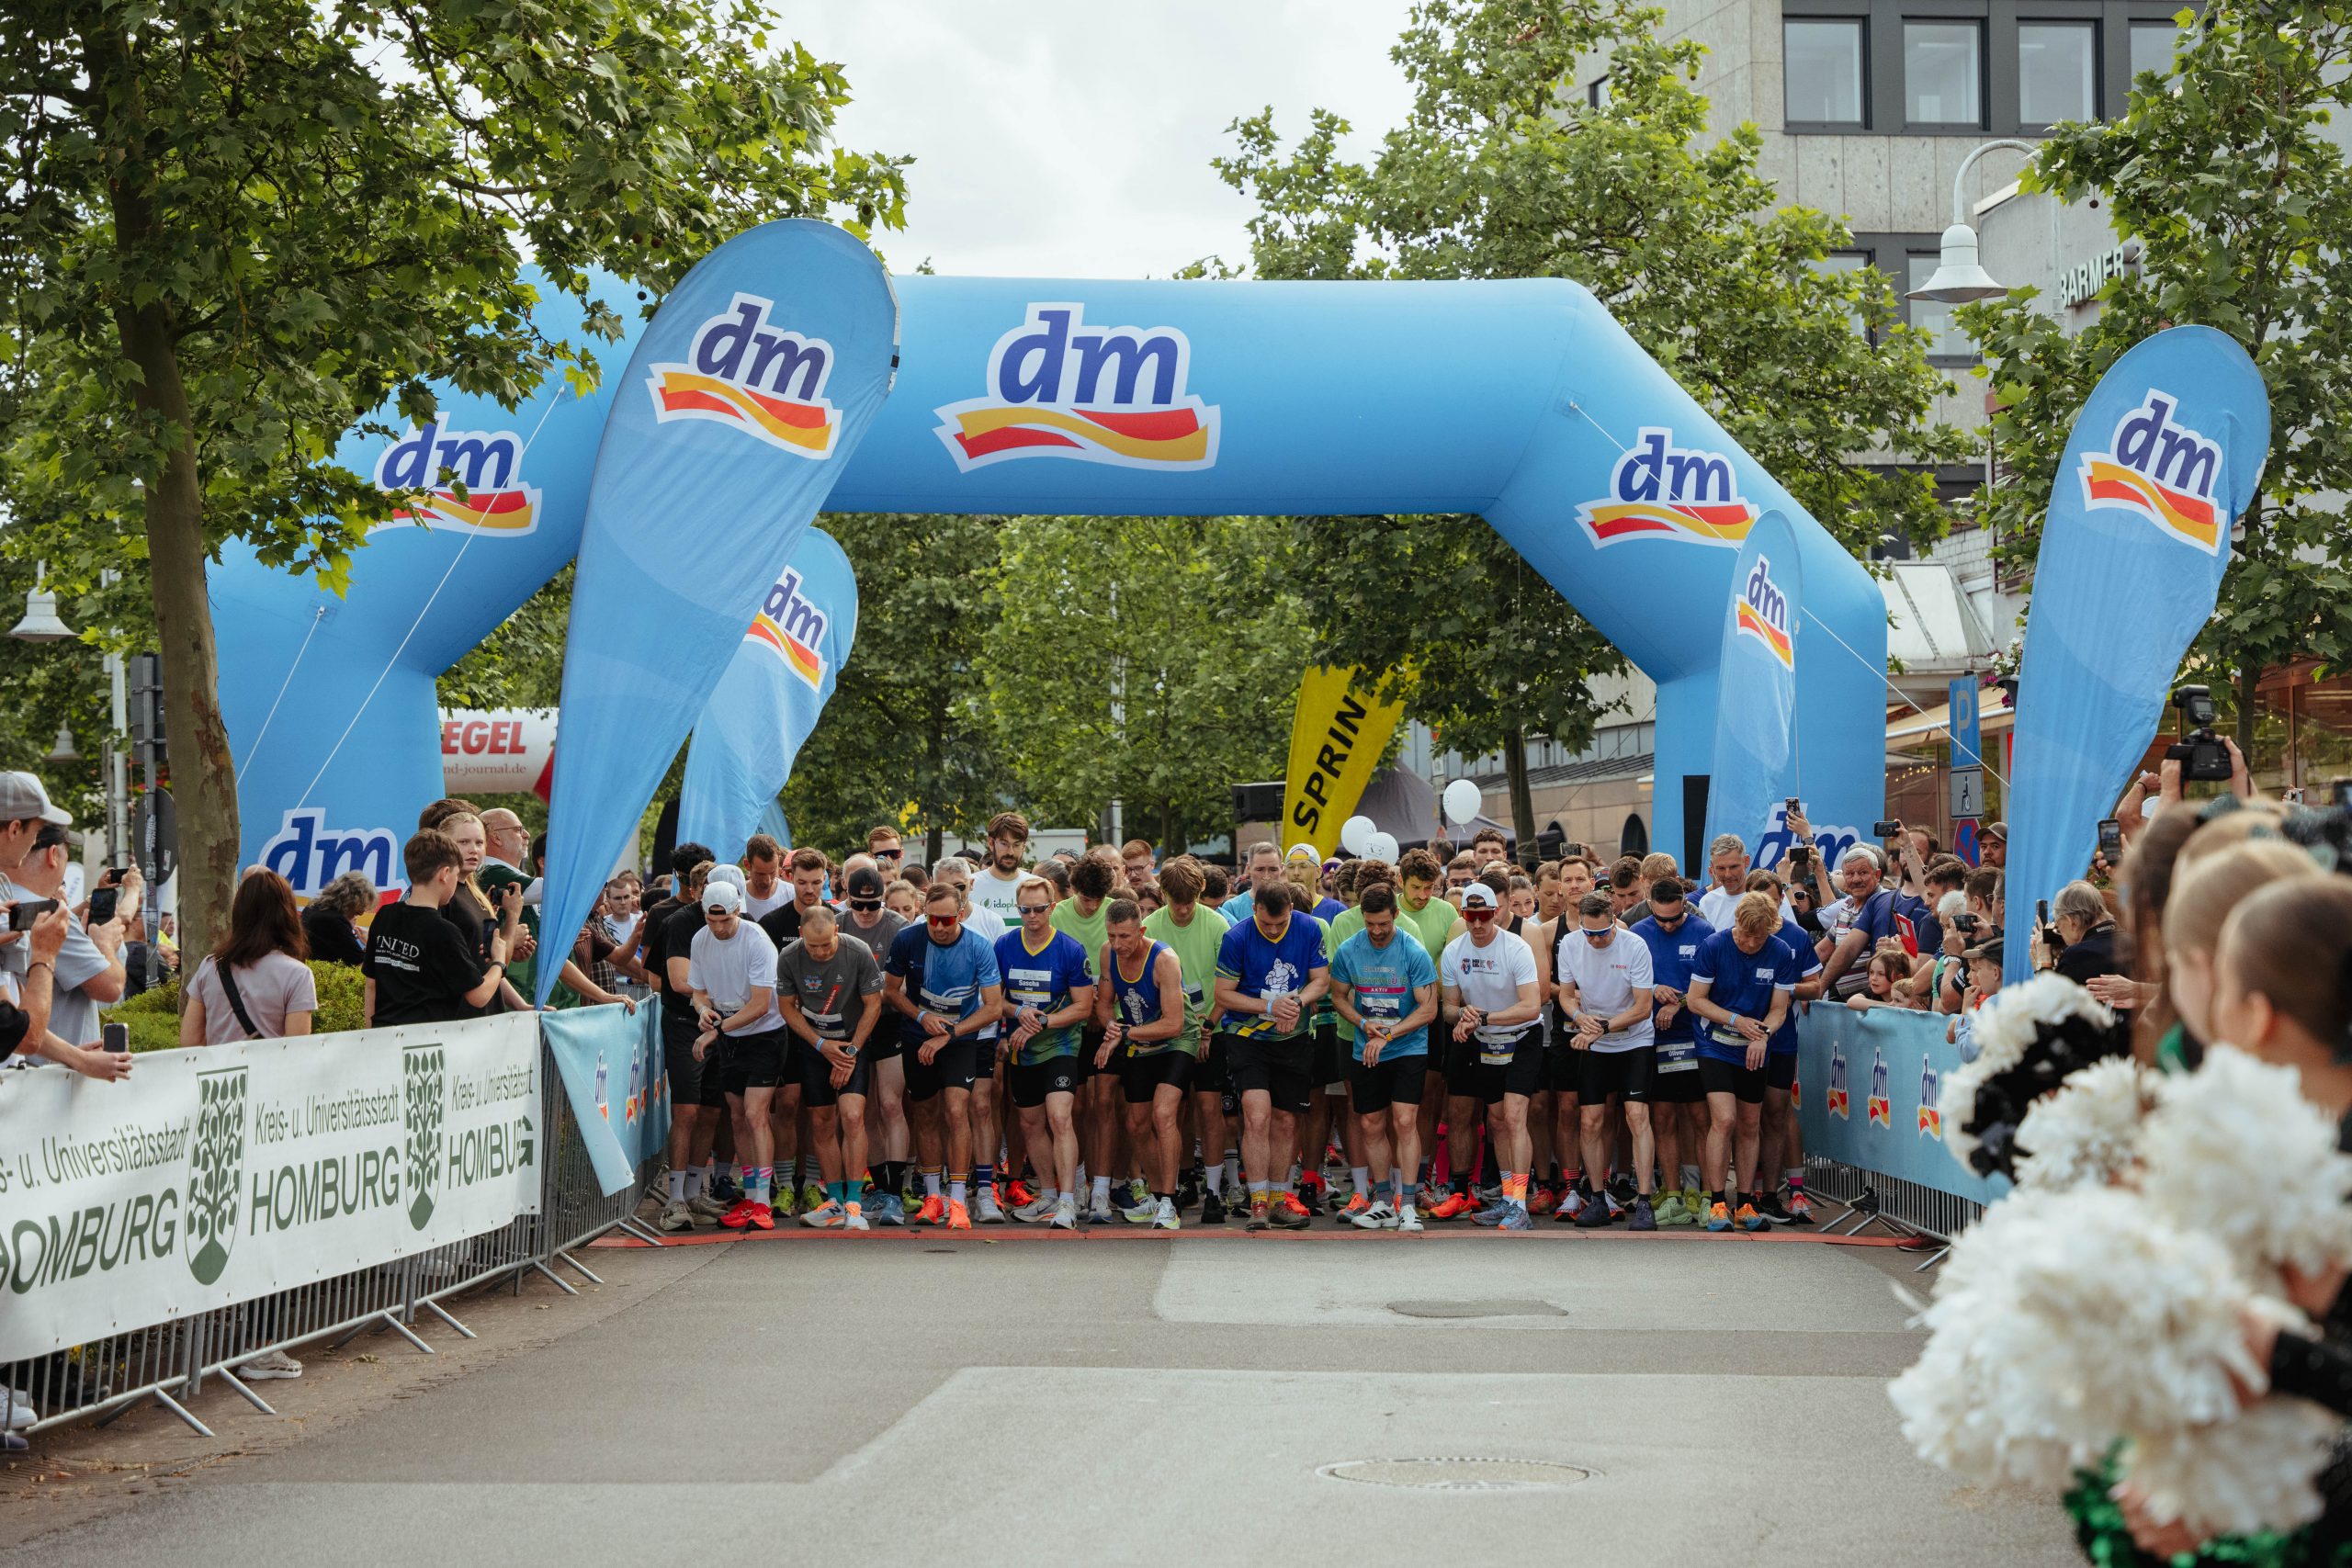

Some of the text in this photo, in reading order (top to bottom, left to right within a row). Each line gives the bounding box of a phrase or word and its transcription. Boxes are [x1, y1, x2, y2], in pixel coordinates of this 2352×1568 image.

[2060, 244, 2125, 308] BARMER
[695, 302, 827, 402] dm
[999, 310, 1179, 405] dm
[381, 419, 520, 489] dm
[1618, 434, 1731, 502] dm
[2116, 398, 2216, 497] dm
[763, 573, 825, 649] dm
[1747, 560, 1787, 632] dm
[1956, 690, 1972, 756] P
[1293, 691, 1375, 835] SPRIN
[266, 816, 390, 891] dm
[930, 1000, 948, 1010] Marco
[1018, 979, 1040, 987] Sascha
[594, 1055, 607, 1104] dm
[1831, 1045, 1846, 1090] dm
[1872, 1052, 1887, 1099] dm
[1921, 1058, 1937, 1108] dm
[255, 1083, 400, 1145] Kreis- u. Universitätsstadt
[18, 1153, 40, 1189] u.
[42, 1116, 190, 1184] Universitätsstadt
[250, 1145, 400, 1236] HOMBURG
